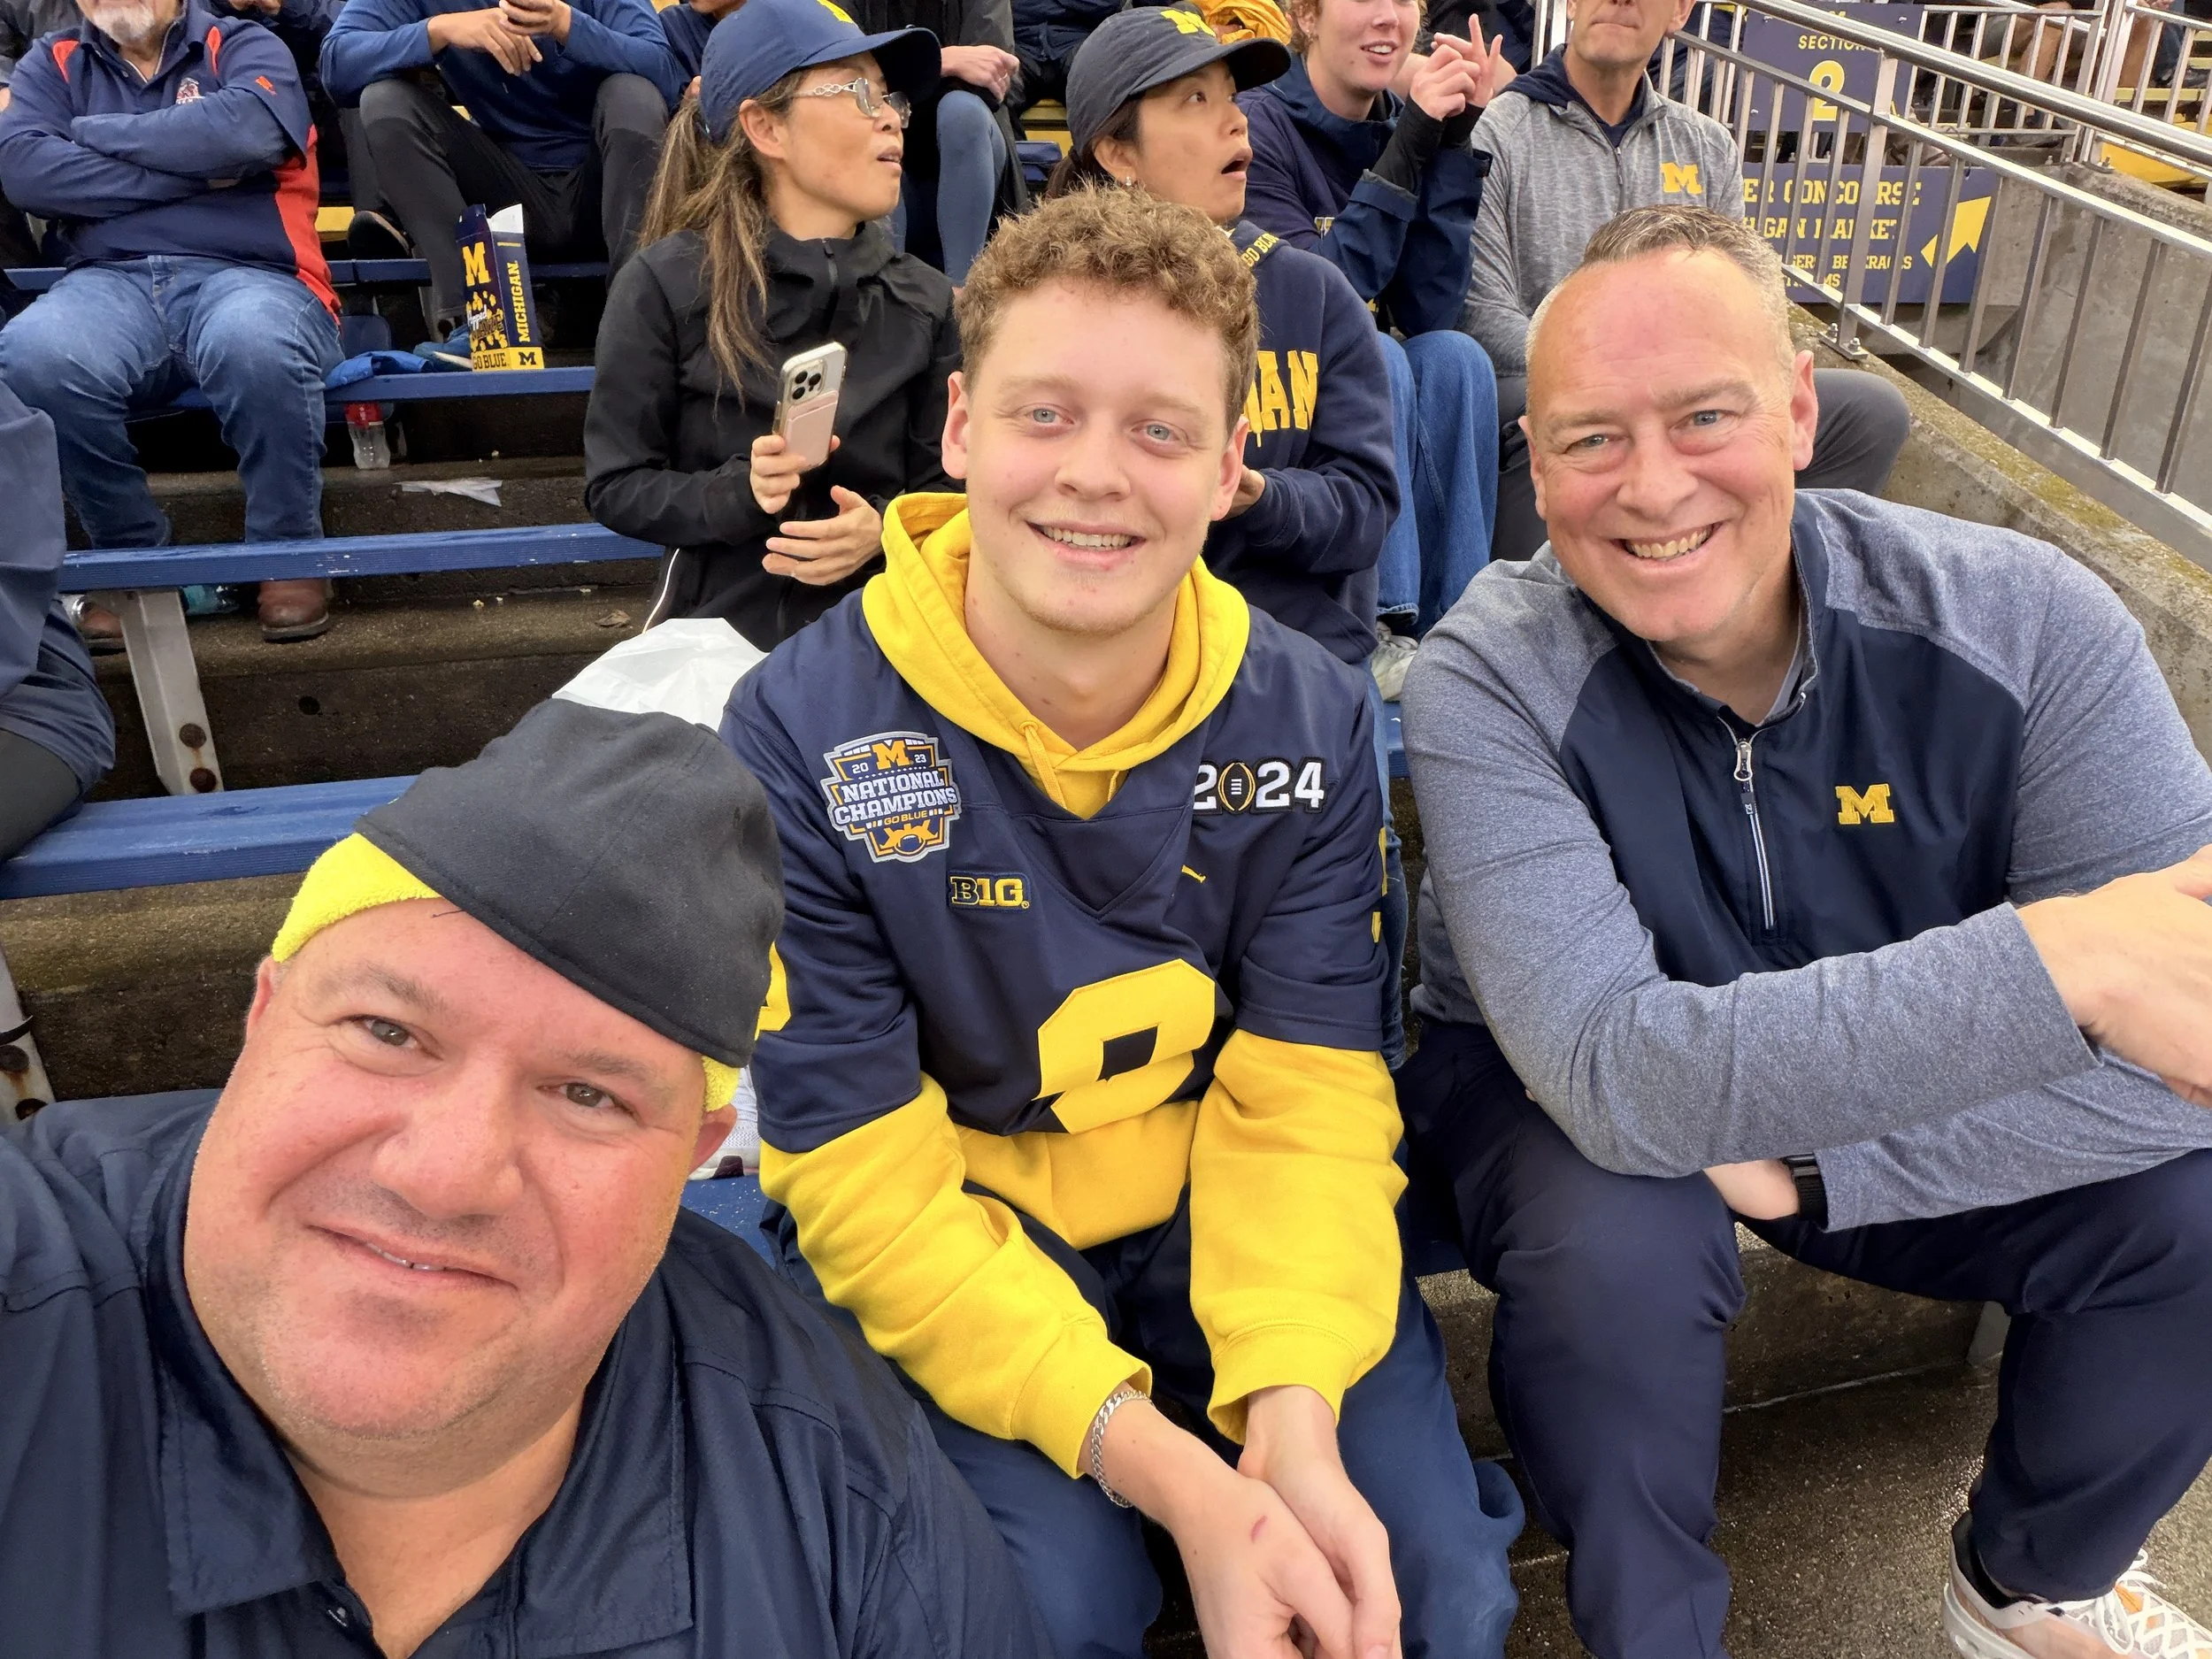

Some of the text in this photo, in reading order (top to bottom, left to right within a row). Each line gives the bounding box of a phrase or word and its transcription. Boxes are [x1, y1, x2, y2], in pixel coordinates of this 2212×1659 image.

[1798, 35, 1865, 50] SECTIO
[1809, 59, 1845, 122] 2
[1660, 162, 1702, 195] M
[462, 242, 492, 288] M
[507, 261, 531, 342] MICHIGAN
[472, 352, 507, 370] GO BLUE
[518, 351, 537, 365] M
[851, 754, 927, 774] 20 23
[872, 740, 911, 770] M
[841, 770, 945, 803] NATIONAL
[834, 787, 958, 826] CHAMPIONS
[884, 810, 928, 826] GO BLUE
[1835, 783, 1894, 825] M
